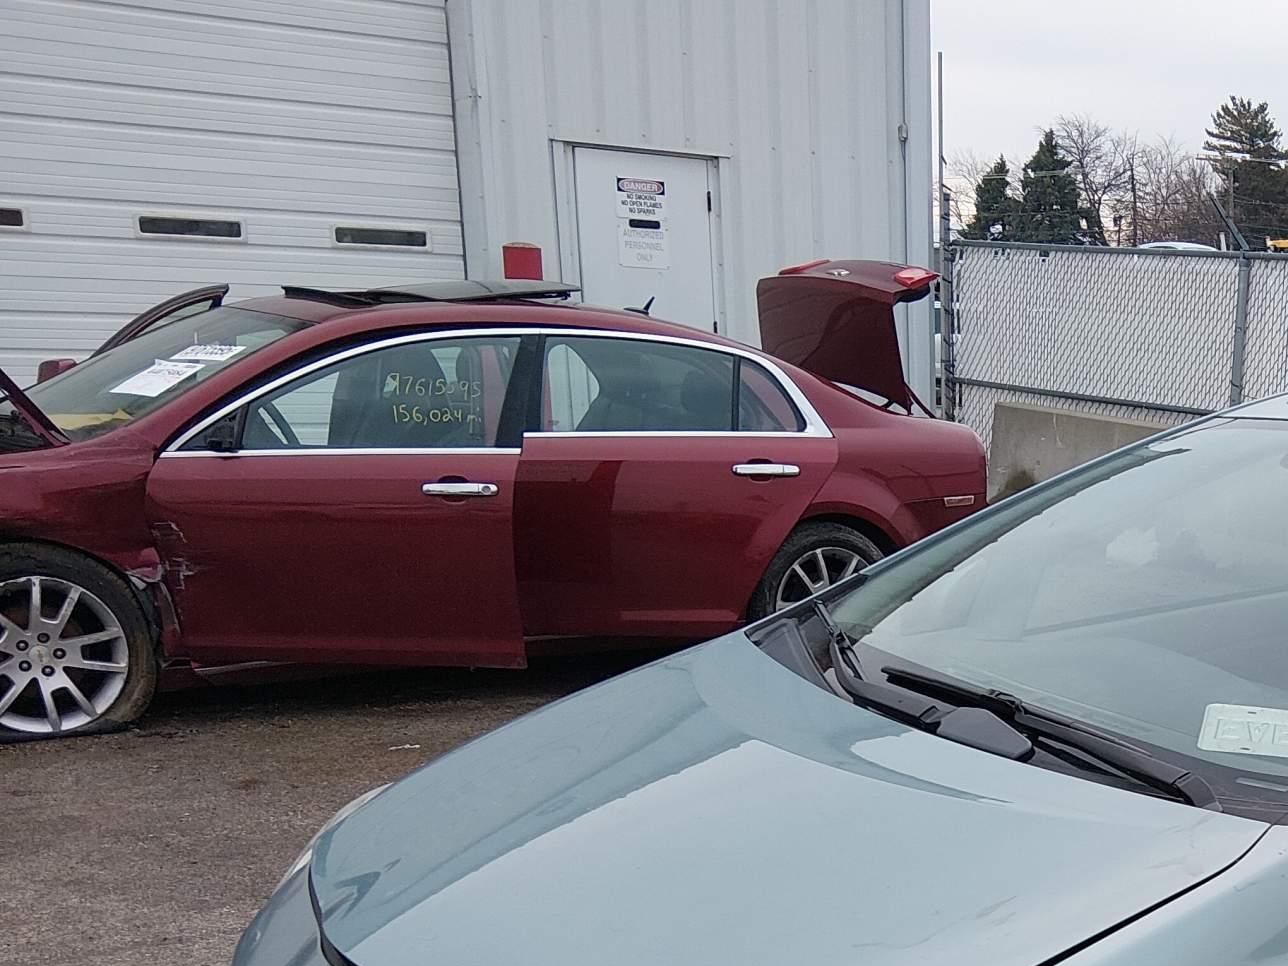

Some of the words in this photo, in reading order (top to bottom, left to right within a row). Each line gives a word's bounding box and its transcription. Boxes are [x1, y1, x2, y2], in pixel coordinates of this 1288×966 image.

[623, 181, 658, 192] DANGER
[635, 194, 657, 202] SMOKING
[623, 228, 664, 240] AUTHORIZED
[623, 240, 664, 252] PERSONNEL
